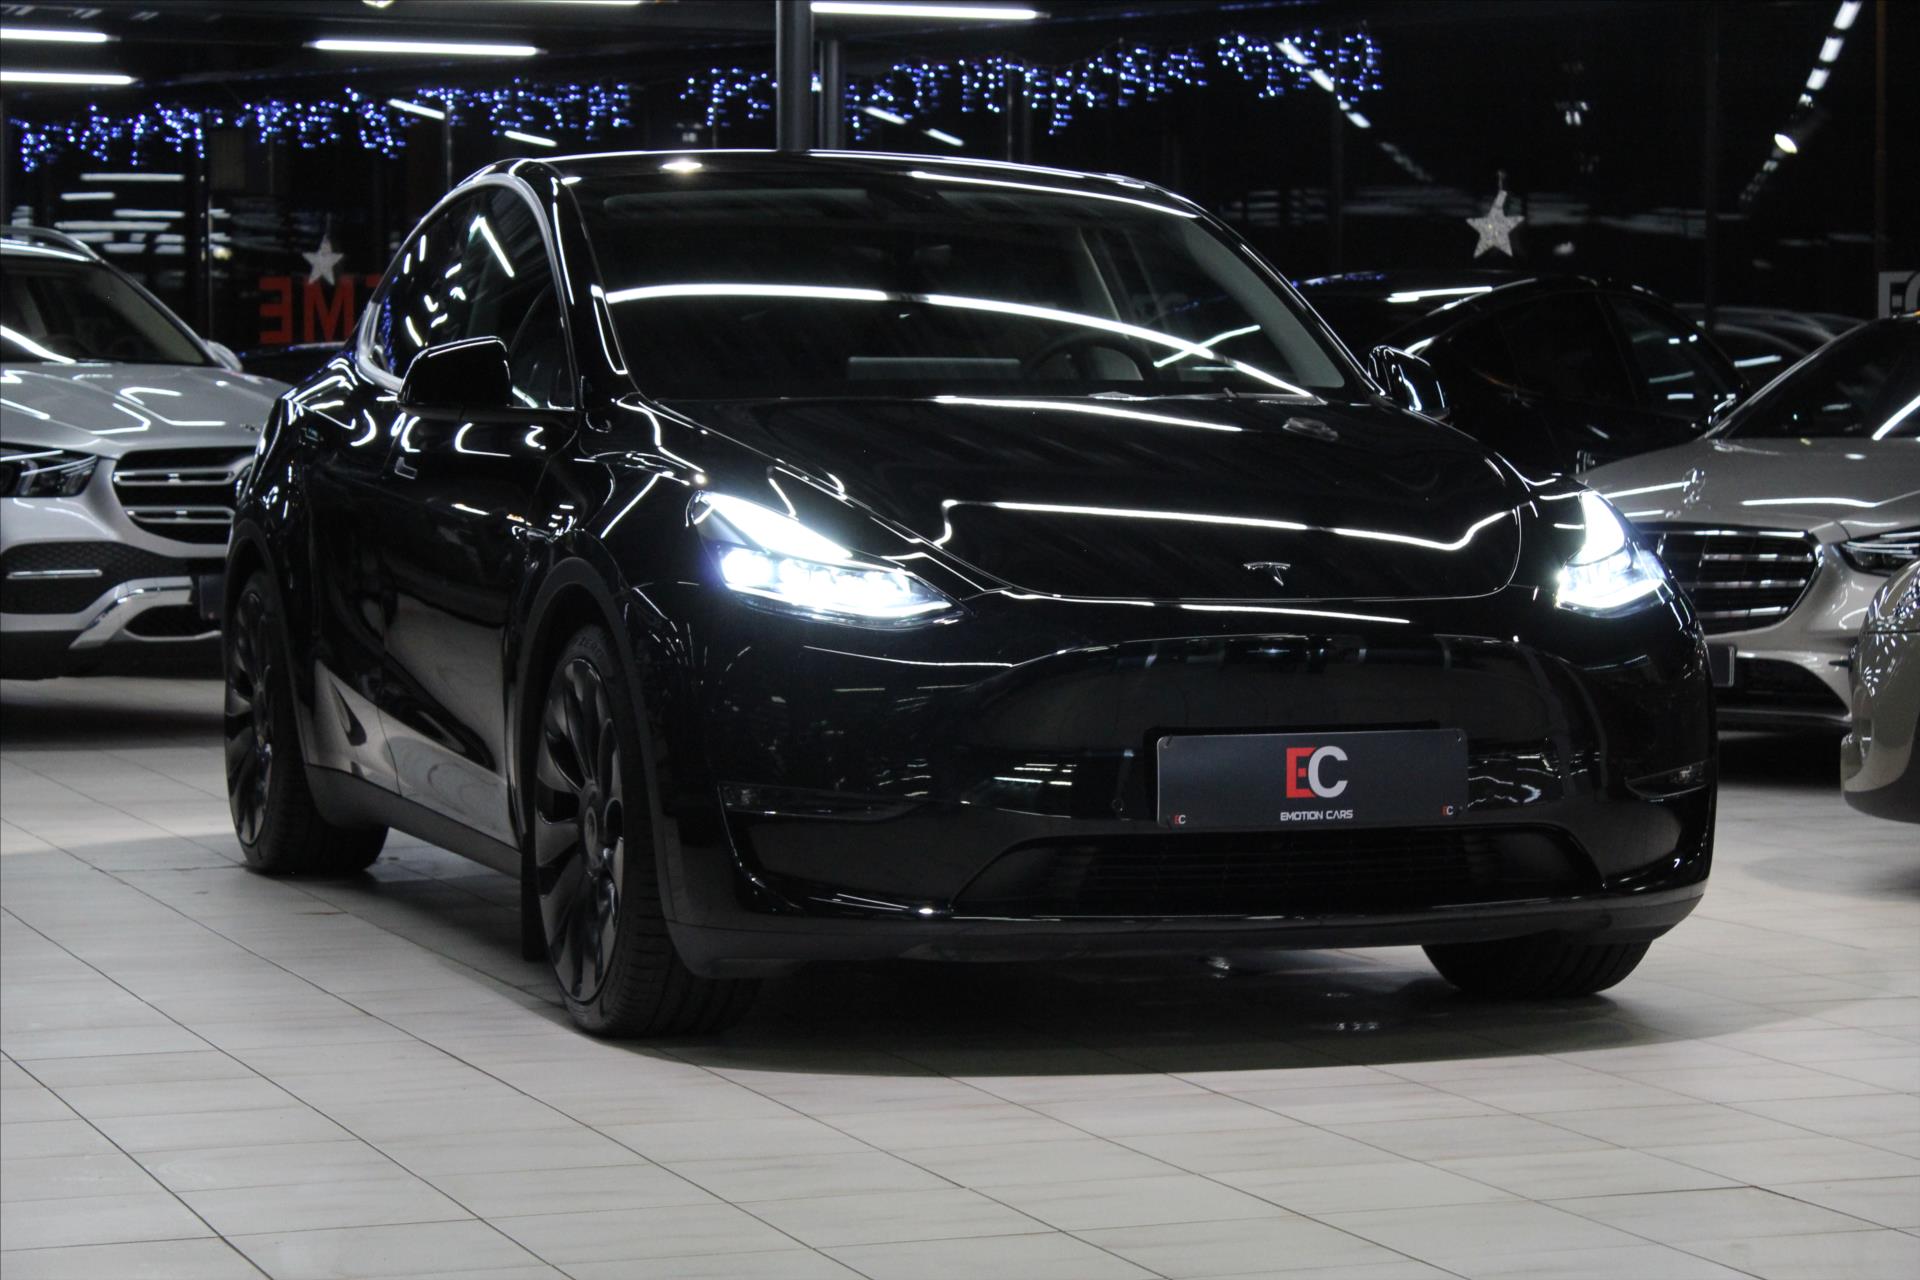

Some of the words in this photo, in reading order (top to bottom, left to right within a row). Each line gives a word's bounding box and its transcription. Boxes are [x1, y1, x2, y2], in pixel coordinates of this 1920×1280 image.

[1286, 745, 1348, 798] EC
[1280, 810, 1323, 821] EMOTION
[1326, 809, 1353, 820] CARS
